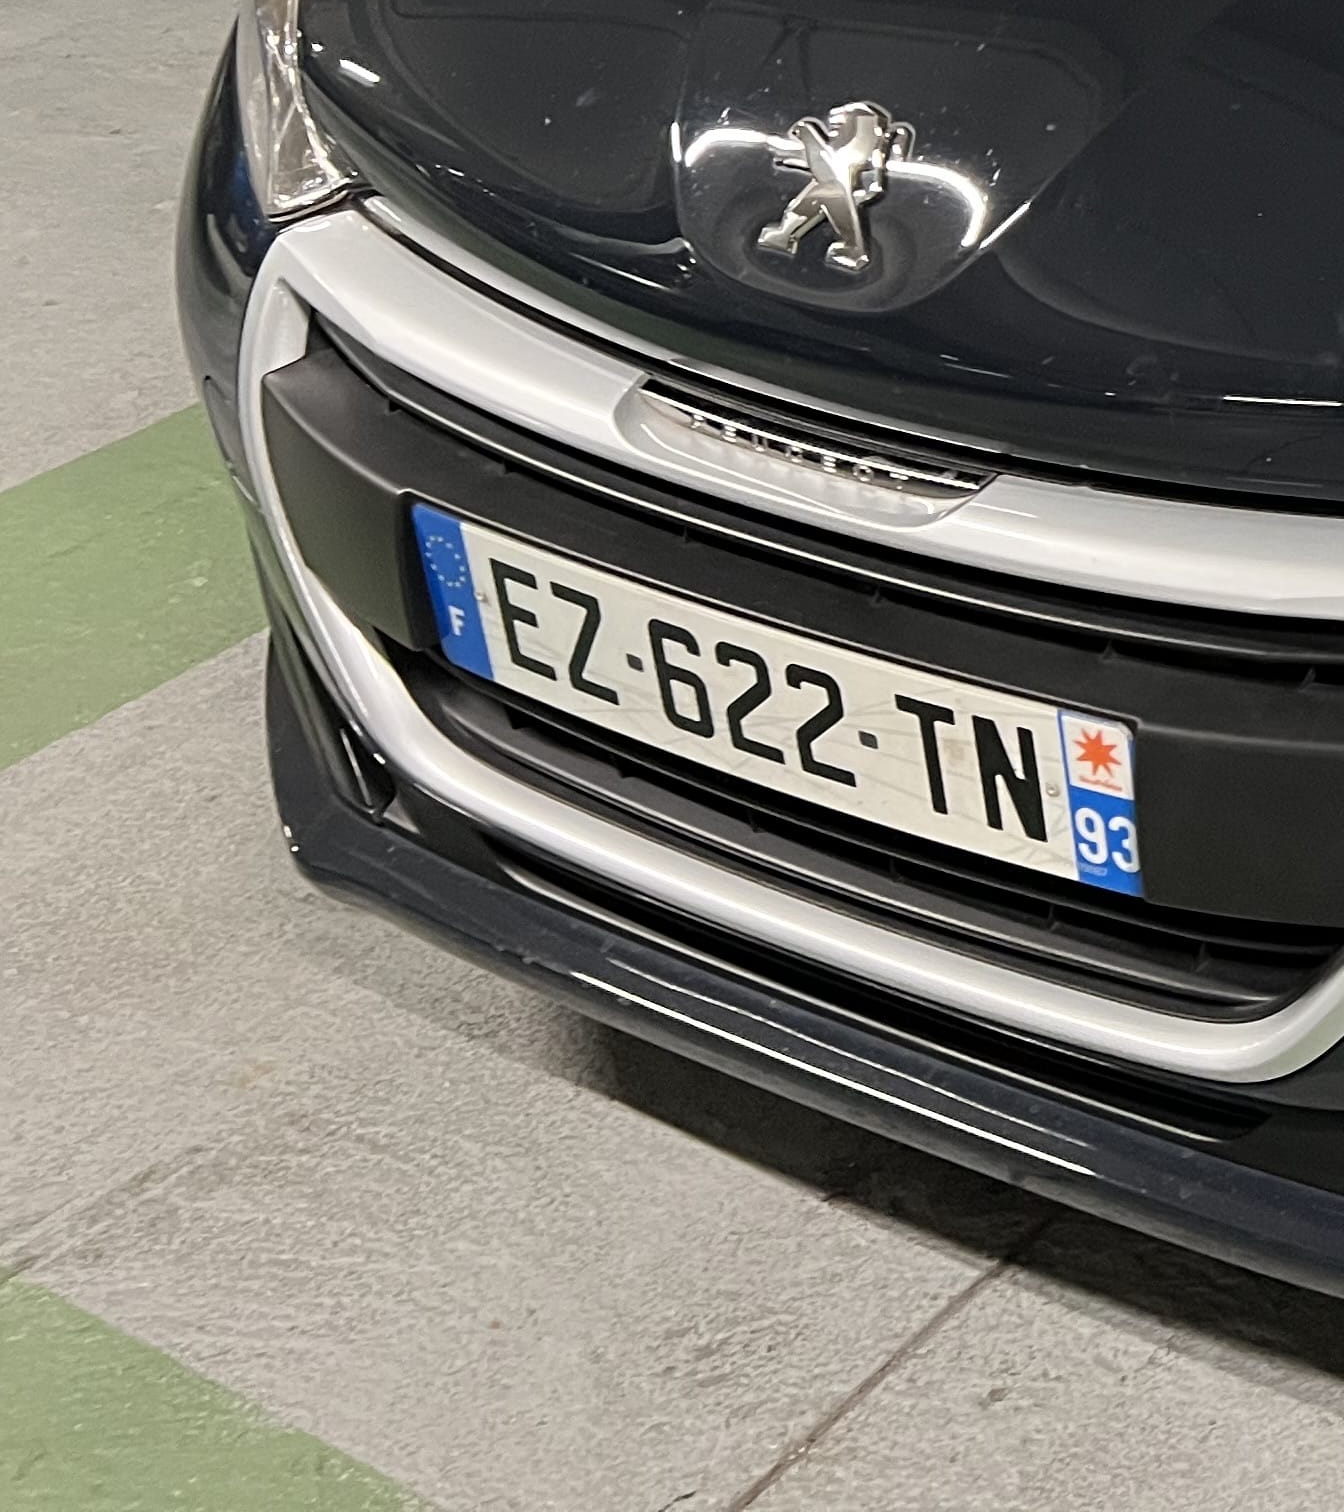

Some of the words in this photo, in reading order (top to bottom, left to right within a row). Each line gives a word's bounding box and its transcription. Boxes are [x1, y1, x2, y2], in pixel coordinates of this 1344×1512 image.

[449, 605, 465, 637] F
[488, 557, 1048, 843] EZ-622-TN
[1074, 807, 1141, 874] 93
